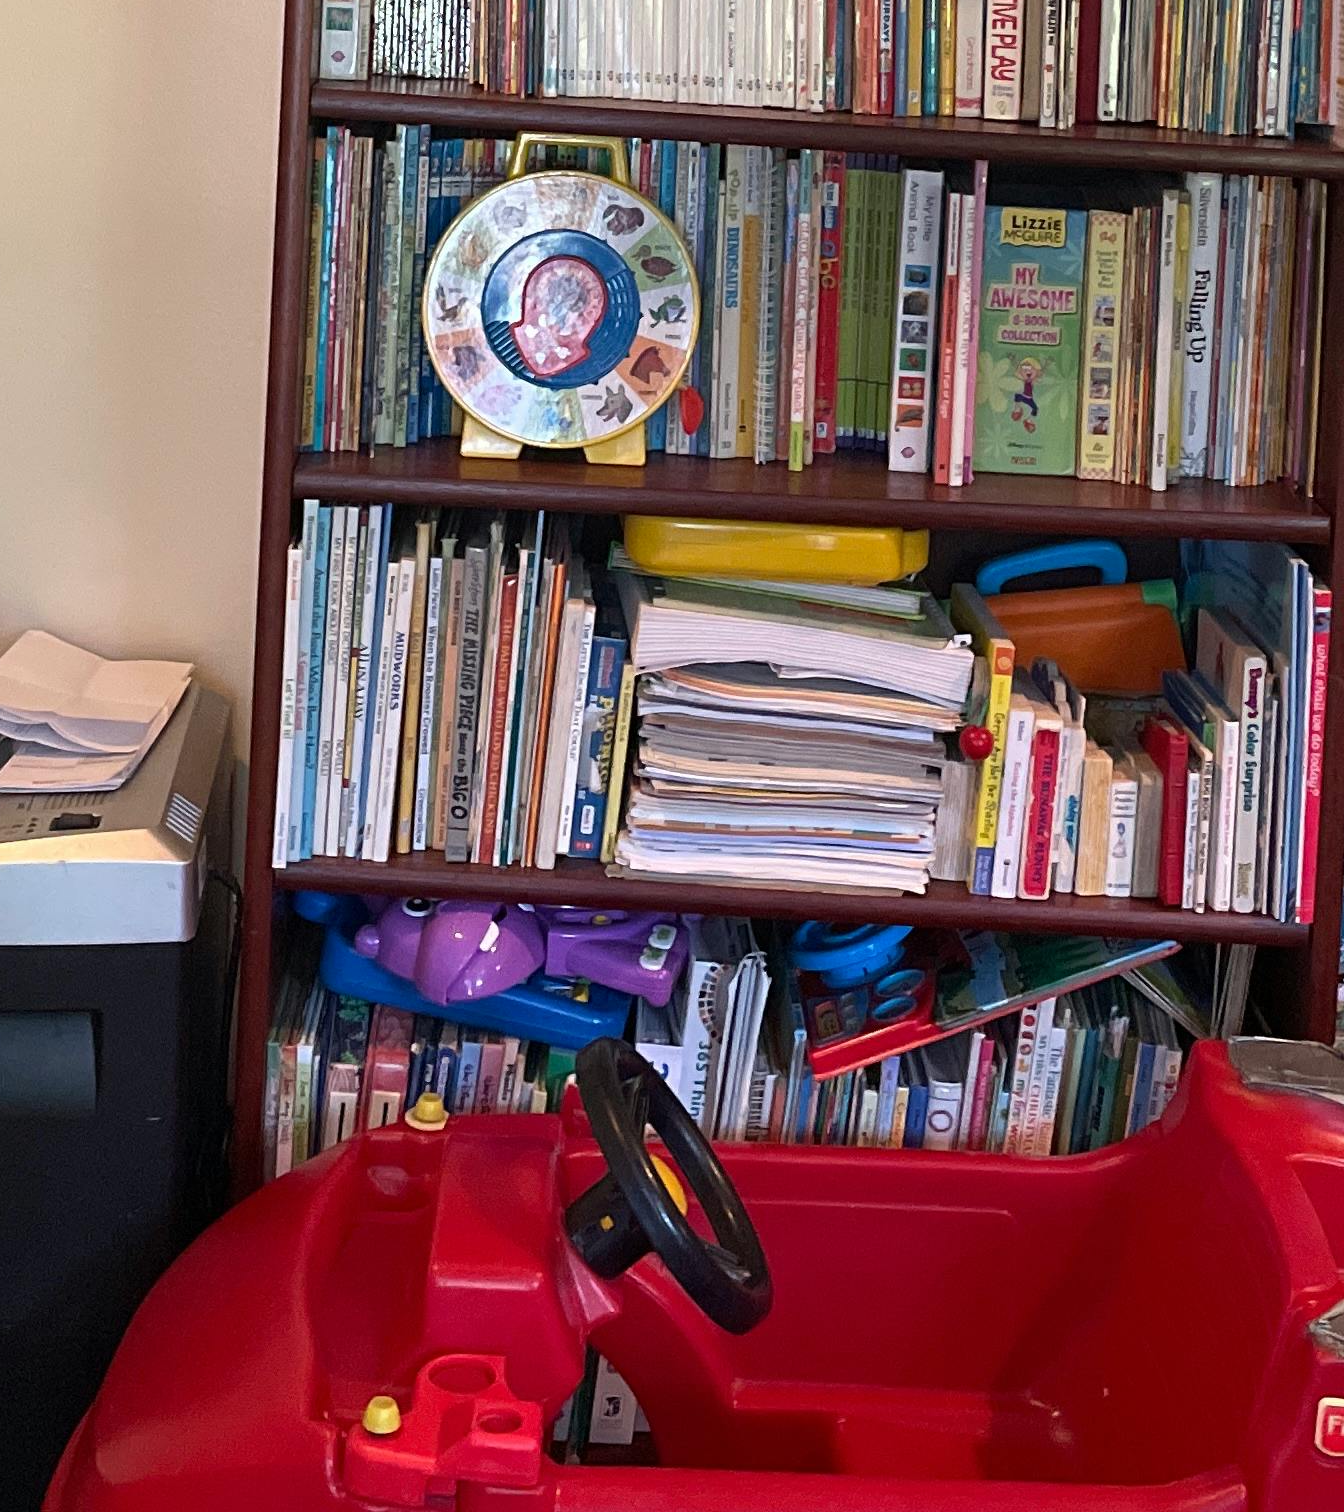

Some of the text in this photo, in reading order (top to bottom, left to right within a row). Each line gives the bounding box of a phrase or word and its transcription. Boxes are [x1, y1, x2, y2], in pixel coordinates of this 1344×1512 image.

[990, 33, 1016, 81] PLAY
[906, 181, 920, 253] Animal Book
[921, 196, 936, 242] My Little
[725, 227, 739, 309] DINOSAURS
[990, 290, 1075, 310] AWESOME
[1015, 267, 1036, 285] MY
[1001, 328, 1058, 343] COLLECTION
[1184, 270, 1211, 363] Falling Up
[341, 579, 354, 629] COMPUTER
[283, 678, 294, 726] Let's Find
[389, 631, 405, 710] MUDWORKS
[420, 626, 437, 755] When the Rooster Crowed
[450, 609, 480, 819] THE MISSING PIECE BIG O
[485, 617, 512, 834] THE PAINTER WHO LOVED CHICKENS
[1306, 644, 1326, 797] what shall we do today?
[1242, 723, 1258, 813] Color Surprise
[1031, 753, 1054, 885] THE RUNAWAY BUNNY
[1041, 1071, 1060, 1118] Fantastic
